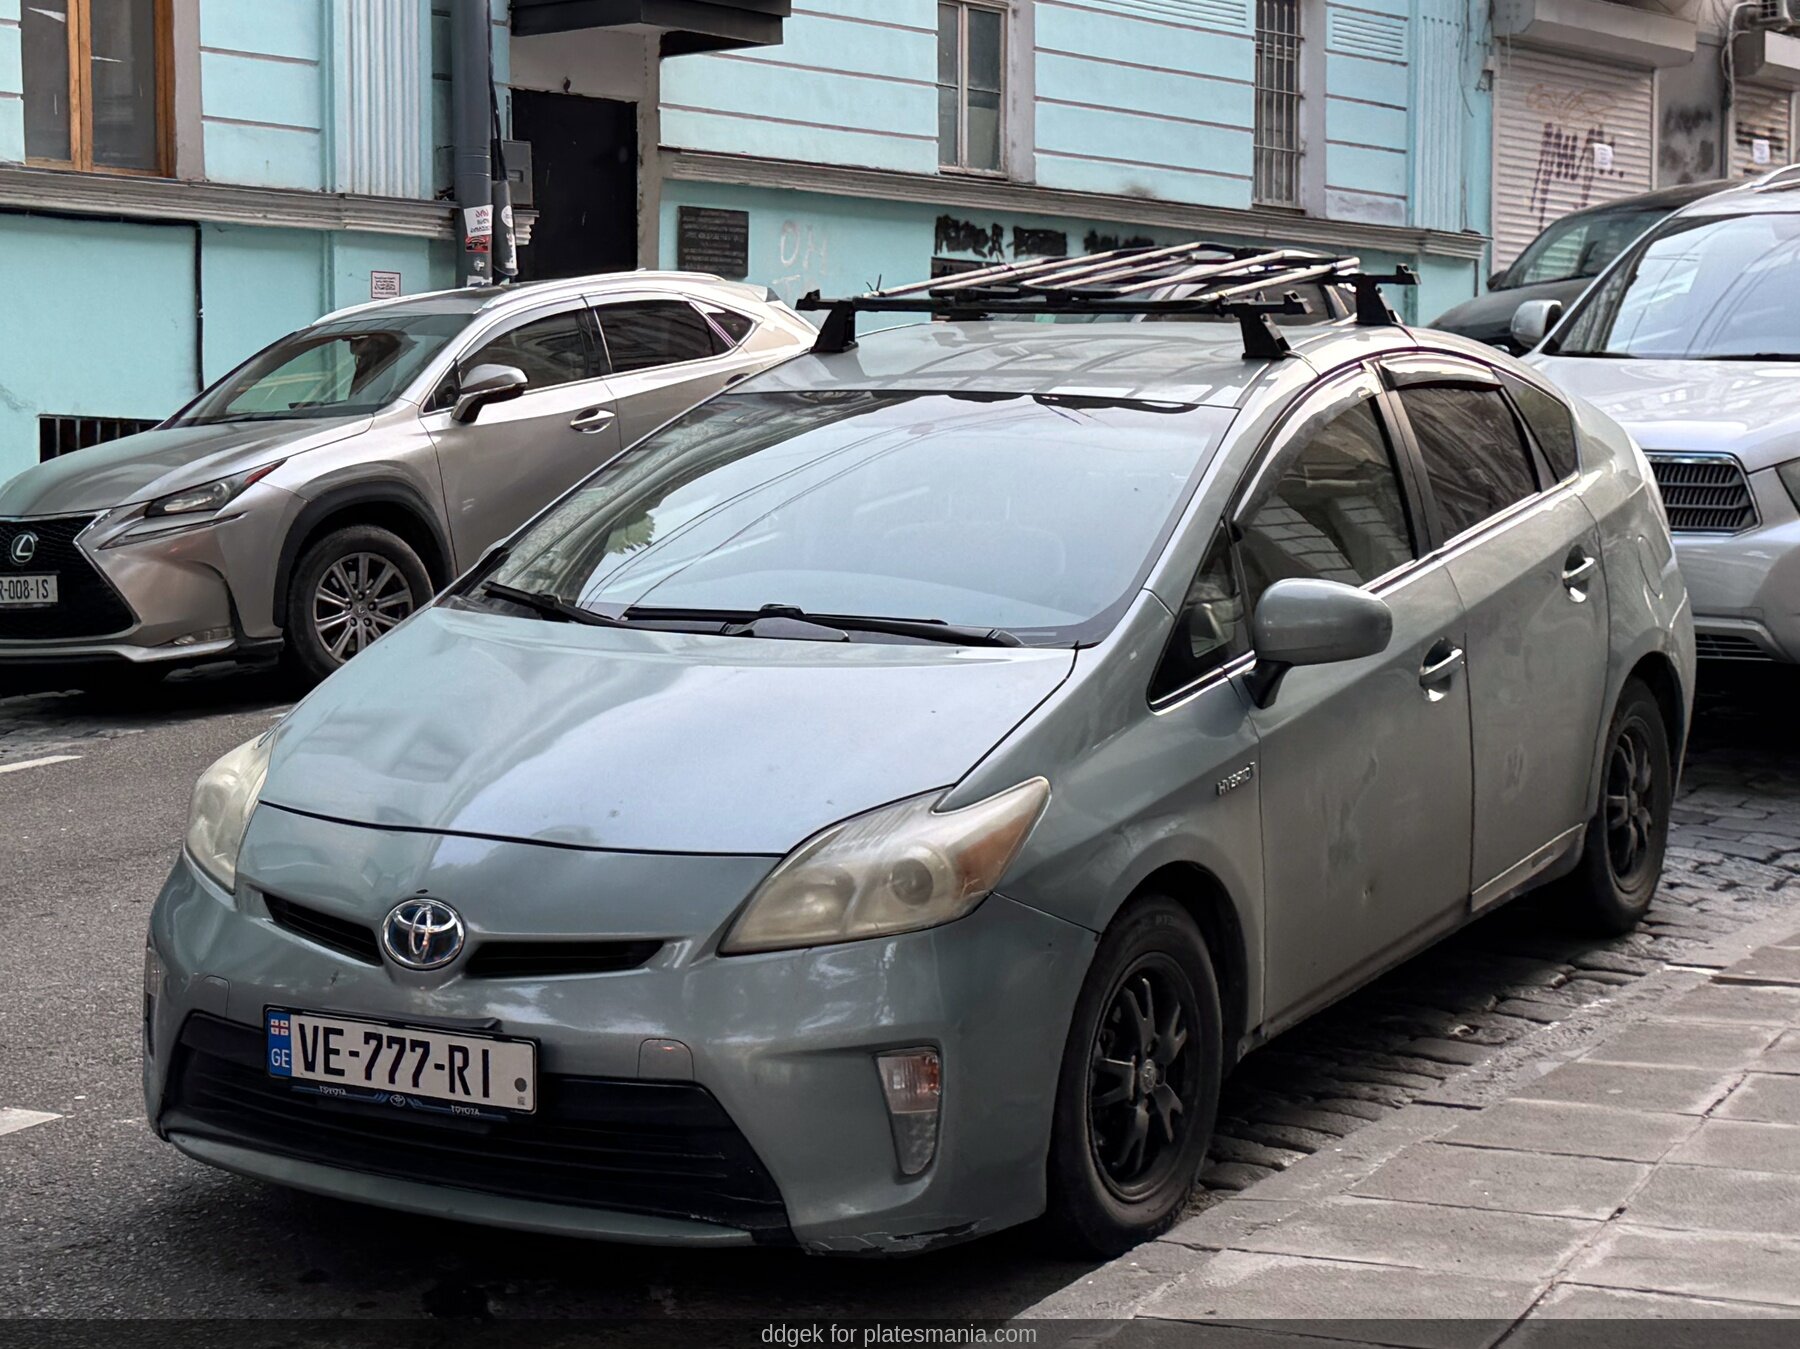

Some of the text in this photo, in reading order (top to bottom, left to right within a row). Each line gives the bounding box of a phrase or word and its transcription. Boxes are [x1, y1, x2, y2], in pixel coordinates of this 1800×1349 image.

[1216, 761, 1256, 796] HYBRID
[271, 1047, 290, 1069] GE
[298, 1022, 491, 1098] VE-777-RI
[319, 1084, 347, 1097] TOYOTA
[450, 1104, 480, 1117] TOYOTA
